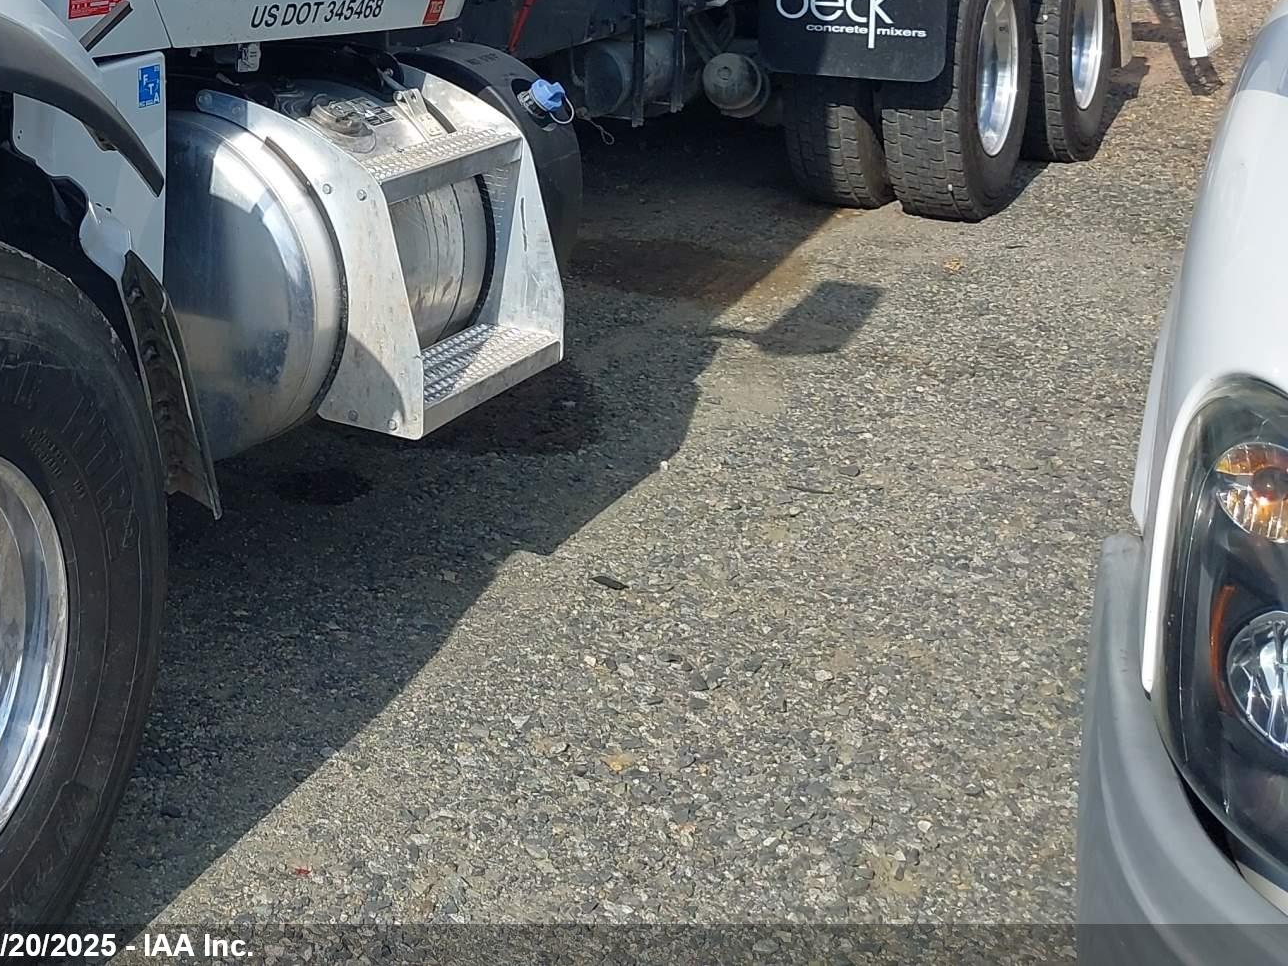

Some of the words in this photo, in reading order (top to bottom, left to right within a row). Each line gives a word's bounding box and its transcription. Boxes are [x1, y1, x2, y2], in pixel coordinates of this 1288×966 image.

[250, 4, 280, 29] US
[281, 1, 325, 27] DOT
[806, 23, 868, 35] concrete
[877, 26, 927, 38] mixers
